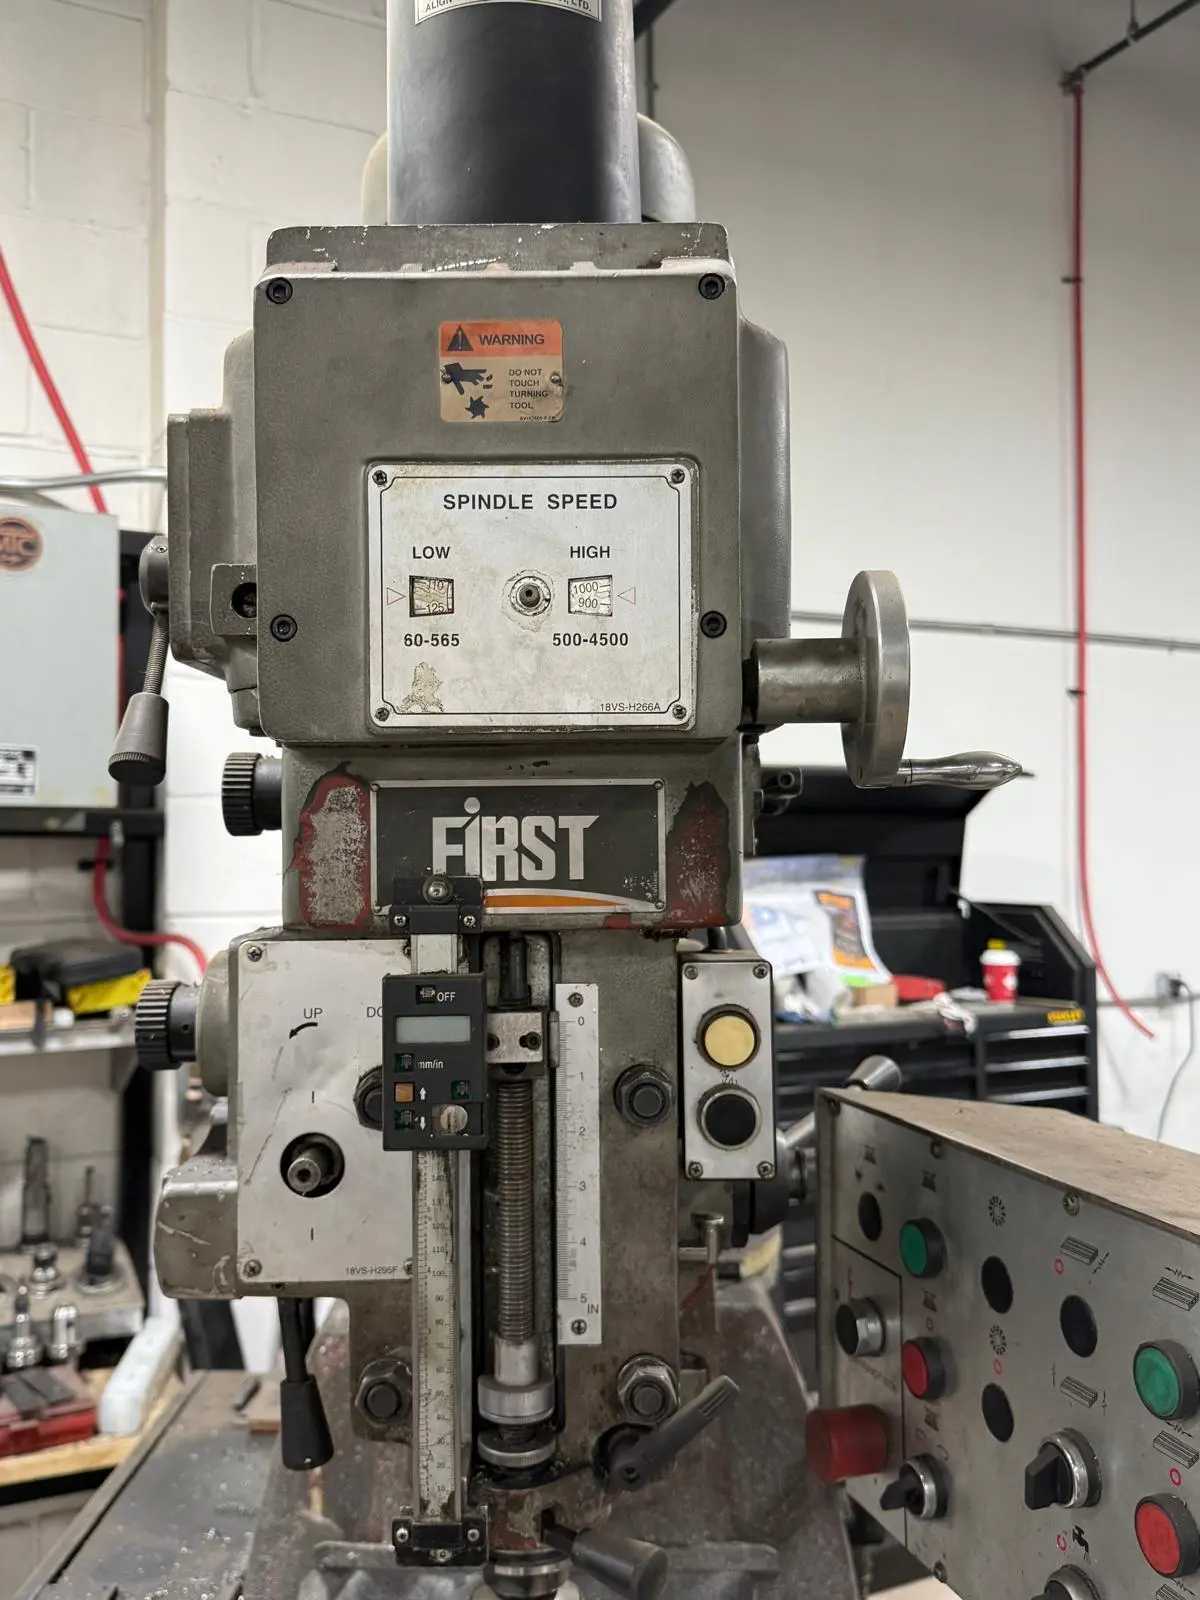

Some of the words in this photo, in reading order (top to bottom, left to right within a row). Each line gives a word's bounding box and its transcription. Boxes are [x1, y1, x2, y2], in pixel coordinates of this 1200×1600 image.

[425, 0, 452, 12] ALIG
[480, 334, 545, 346] WARNING
[510, 379, 540, 387] TOUCH
[510, 390, 549, 398] TURNING
[443, 494, 534, 510] SPINDLE
[547, 494, 618, 510] SPEED
[412, 546, 451, 559] LOW
[569, 545, 611, 559] HIGH
[574, 581, 599, 594] 1000
[578, 597, 598, 609] 900
[403, 633, 460, 647] 60-565
[552, 632, 629, 647] 500-4500
[600, 702, 661, 712] 18VS-H266A
[437, 992, 456, 1002] OFF
[303, 1007, 323, 1019] UP
[578, 1016, 585, 1026] 0
[418, 1059, 444, 1070] mm/in
[578, 1127, 586, 1136] 2
[579, 1180, 587, 1192] 3
[579, 1236, 587, 1247] 4
[580, 1293, 588, 1304] 5
[587, 1304, 599, 1315] IN
